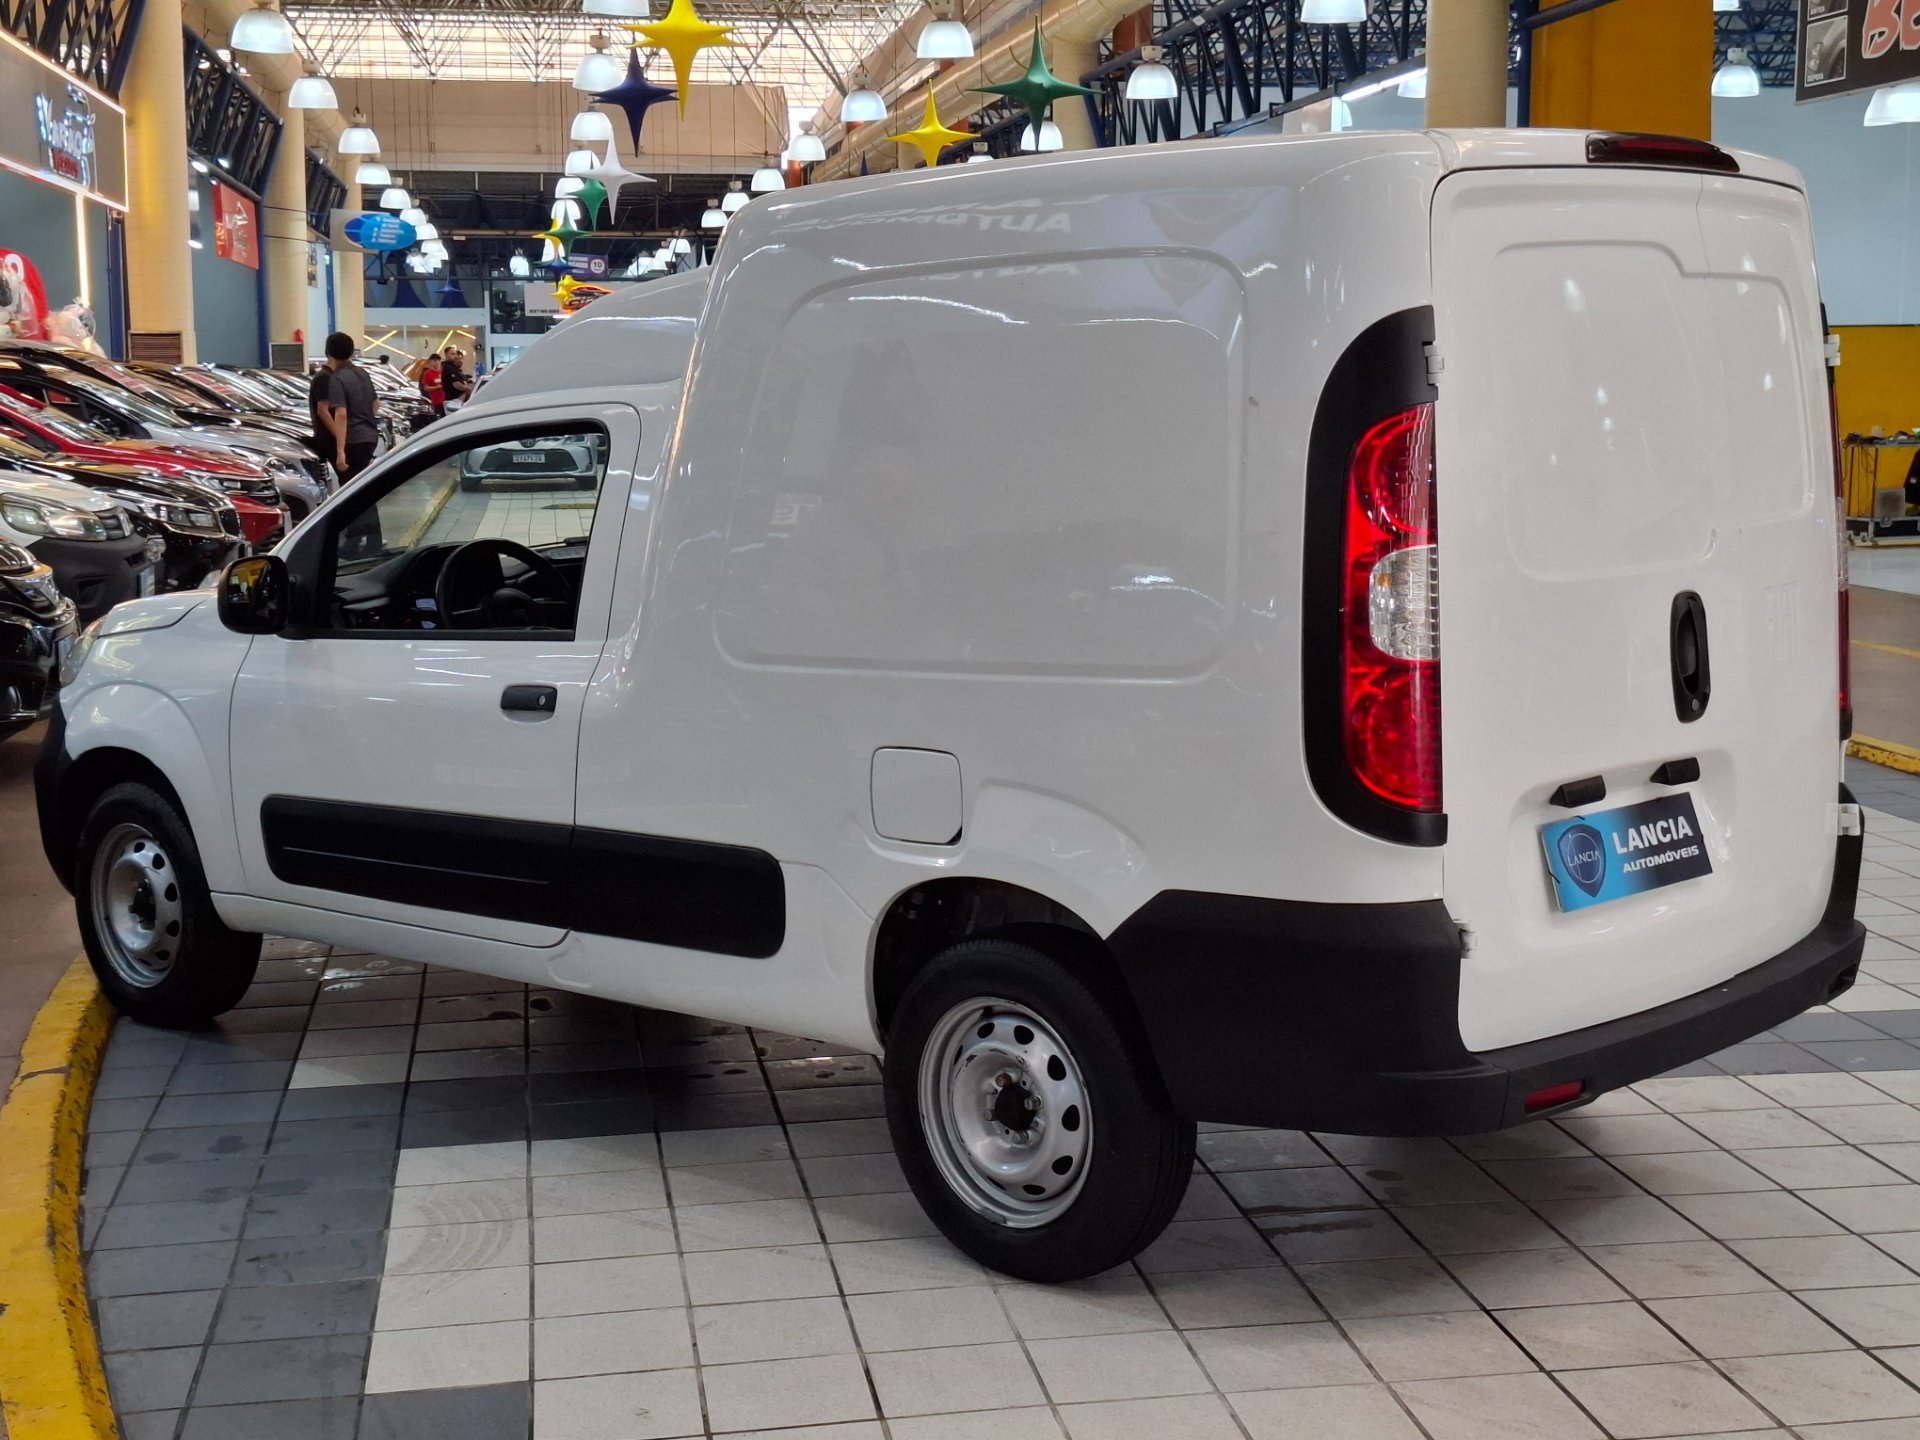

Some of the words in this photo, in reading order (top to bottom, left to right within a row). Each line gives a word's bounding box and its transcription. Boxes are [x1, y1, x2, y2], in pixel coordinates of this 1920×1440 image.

[1612, 815, 1694, 855] LANCIA
[1567, 849, 1601, 867] LANCIA
[1623, 845, 1700, 874] AUTOMÓVEIS
